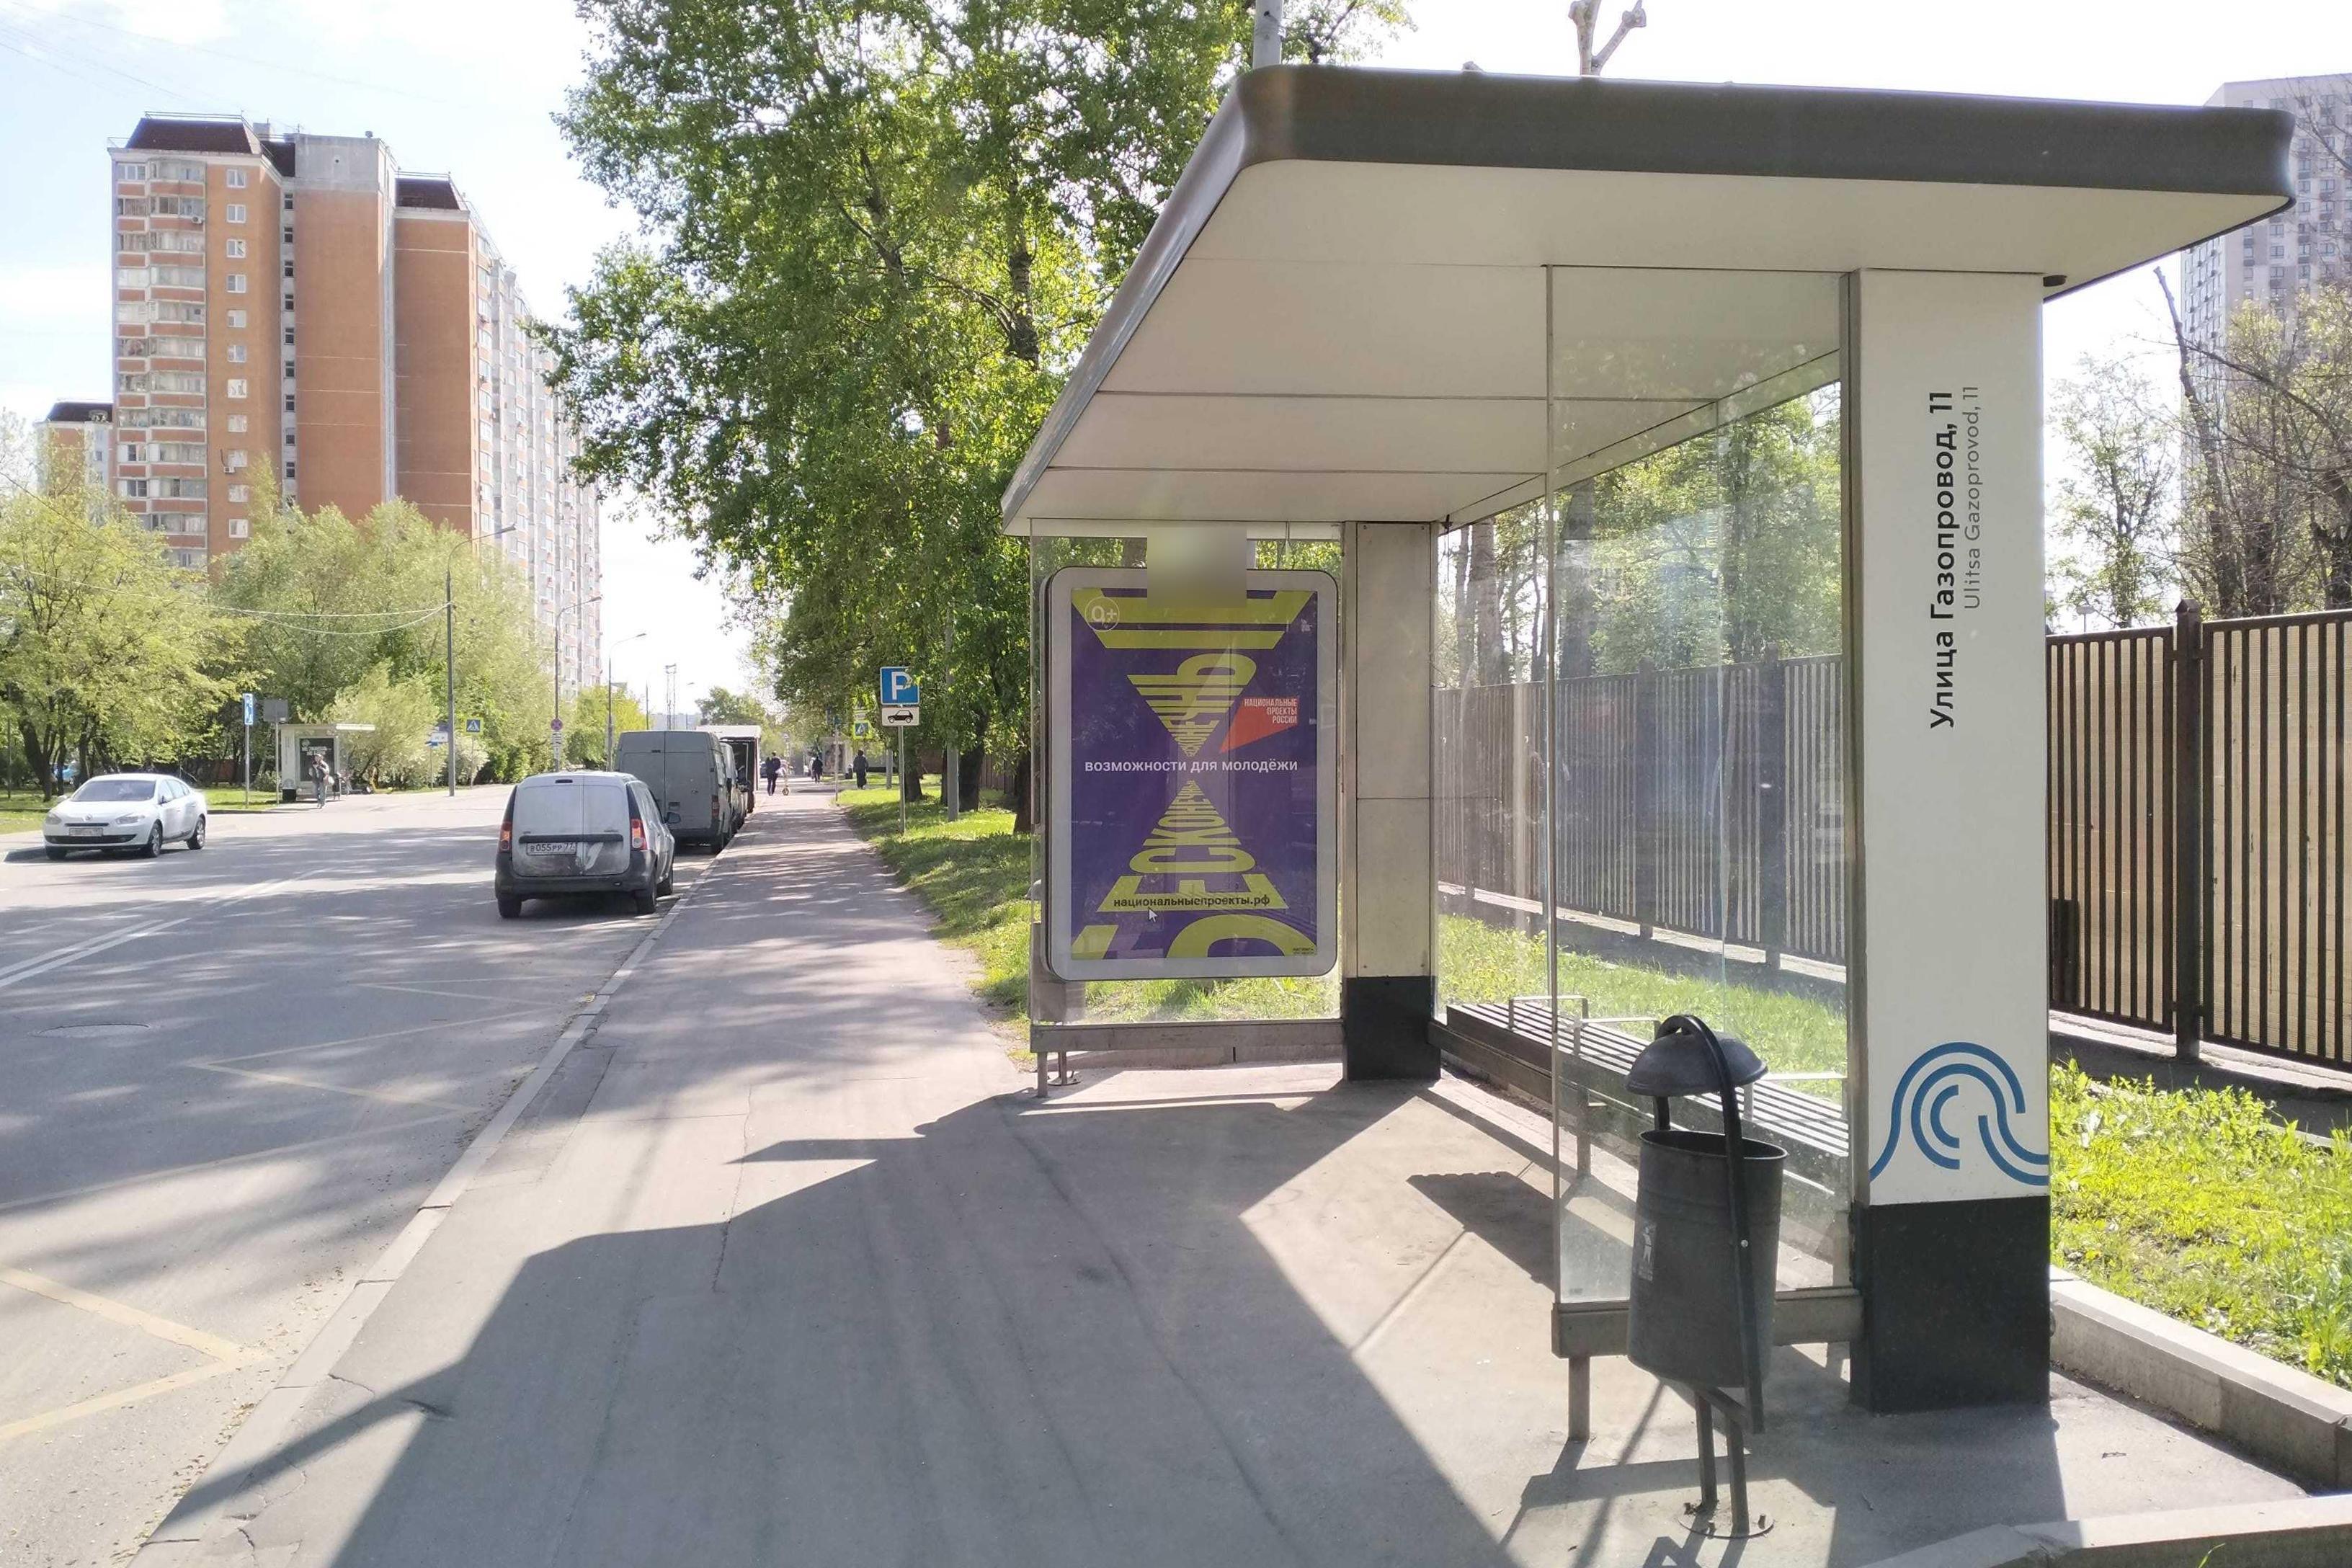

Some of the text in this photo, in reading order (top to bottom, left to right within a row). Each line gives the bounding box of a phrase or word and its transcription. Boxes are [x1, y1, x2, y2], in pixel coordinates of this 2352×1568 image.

[1962, 387, 1983, 609] Ulitsa Gazoprovod, 11
[1930, 393, 1960, 729] Улица Газопровод, 11
[891, 672, 913, 700] P
[1244, 698, 1297, 707] НАЦИОНАЛЬНЫЕ
[1084, 758, 1298, 773] возможности для молодёжи
[1113, 894, 1270, 908] национальныепроекты.рф
